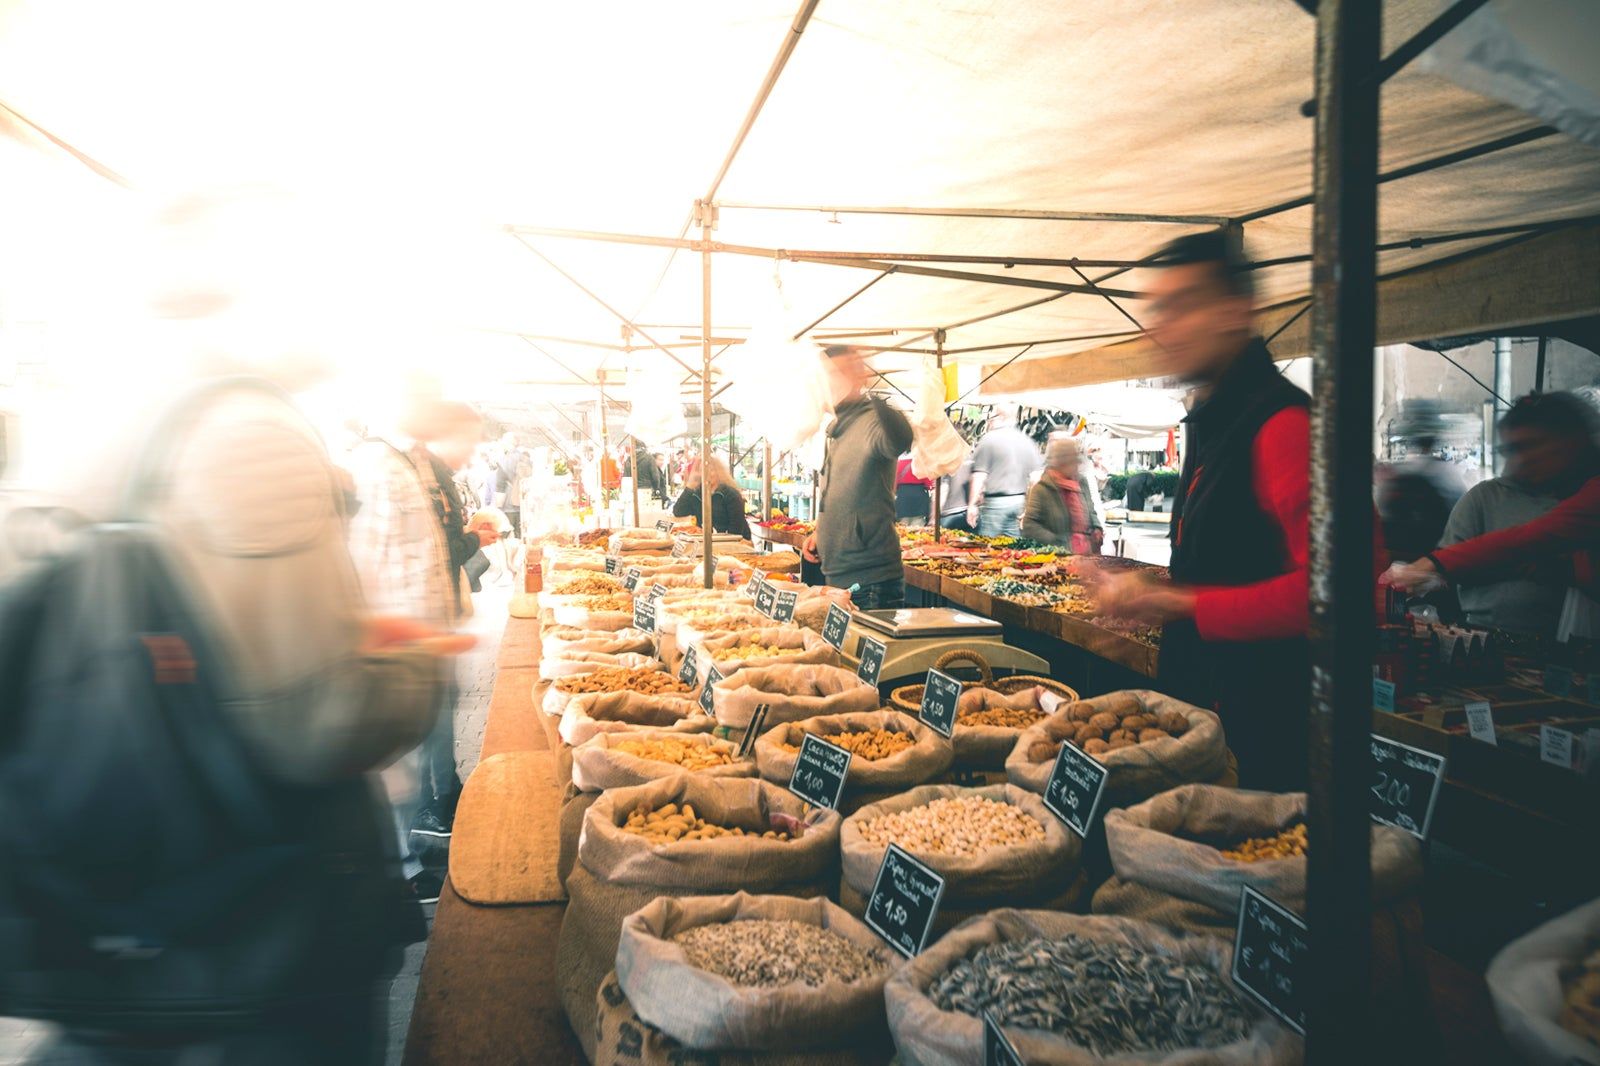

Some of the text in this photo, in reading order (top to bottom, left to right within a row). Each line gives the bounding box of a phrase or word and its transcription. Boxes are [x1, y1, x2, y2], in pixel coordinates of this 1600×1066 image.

[930, 701, 944, 717] 1,50
[804, 771, 823, 790] 1,00
[1051, 779, 1079, 809] € 1,50
[874, 892, 907, 925] € 1,50
